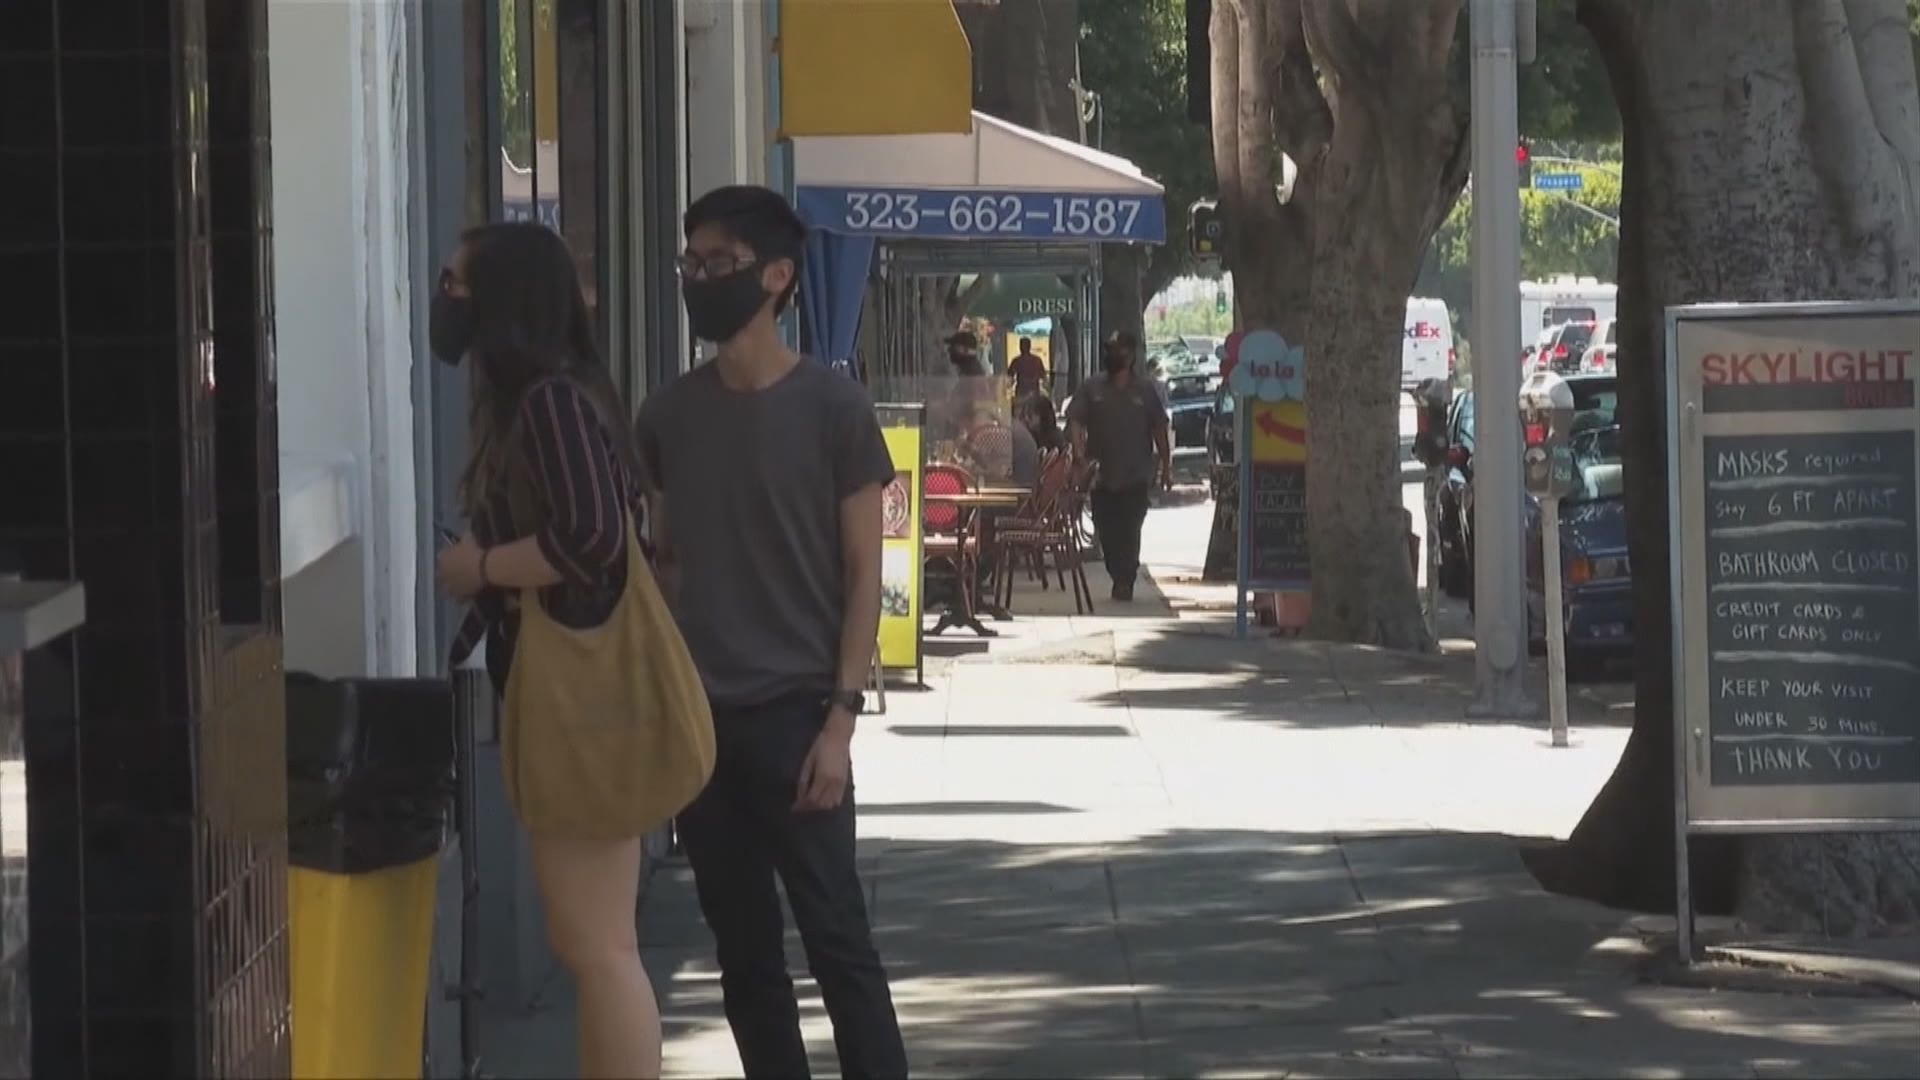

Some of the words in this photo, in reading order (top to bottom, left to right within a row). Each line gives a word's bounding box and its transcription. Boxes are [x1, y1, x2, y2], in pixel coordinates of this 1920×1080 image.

[845, 193, 1142, 234] 323-662-1587
[1701, 350, 1913, 386] SKYLIGHT
[1718, 449, 1790, 477] MASKS
[1804, 447, 1881, 473] required
[1768, 492, 1782, 516] 6
[1793, 489, 1815, 512] FT
[1834, 488, 1897, 513] APART
[1718, 550, 1820, 578] BATHROOM
[1832, 549, 1910, 575] CLOSED
[1716, 601, 1781, 618] CREDIT
[1793, 603, 1843, 619] CARDS
[1732, 623, 1769, 641] GIFT
[1778, 624, 1827, 642] CARDS
[1842, 629, 1882, 643] ONLY
[1720, 677, 1770, 699] KEEP
[1782, 679, 1824, 698] YOUR
[1832, 682, 1873, 698] VISIT
[1735, 712, 1788, 729] UNDER
[1808, 716, 1828, 731] 30
[1729, 746, 1812, 775] THANK
[1828, 747, 1882, 770] YOU
